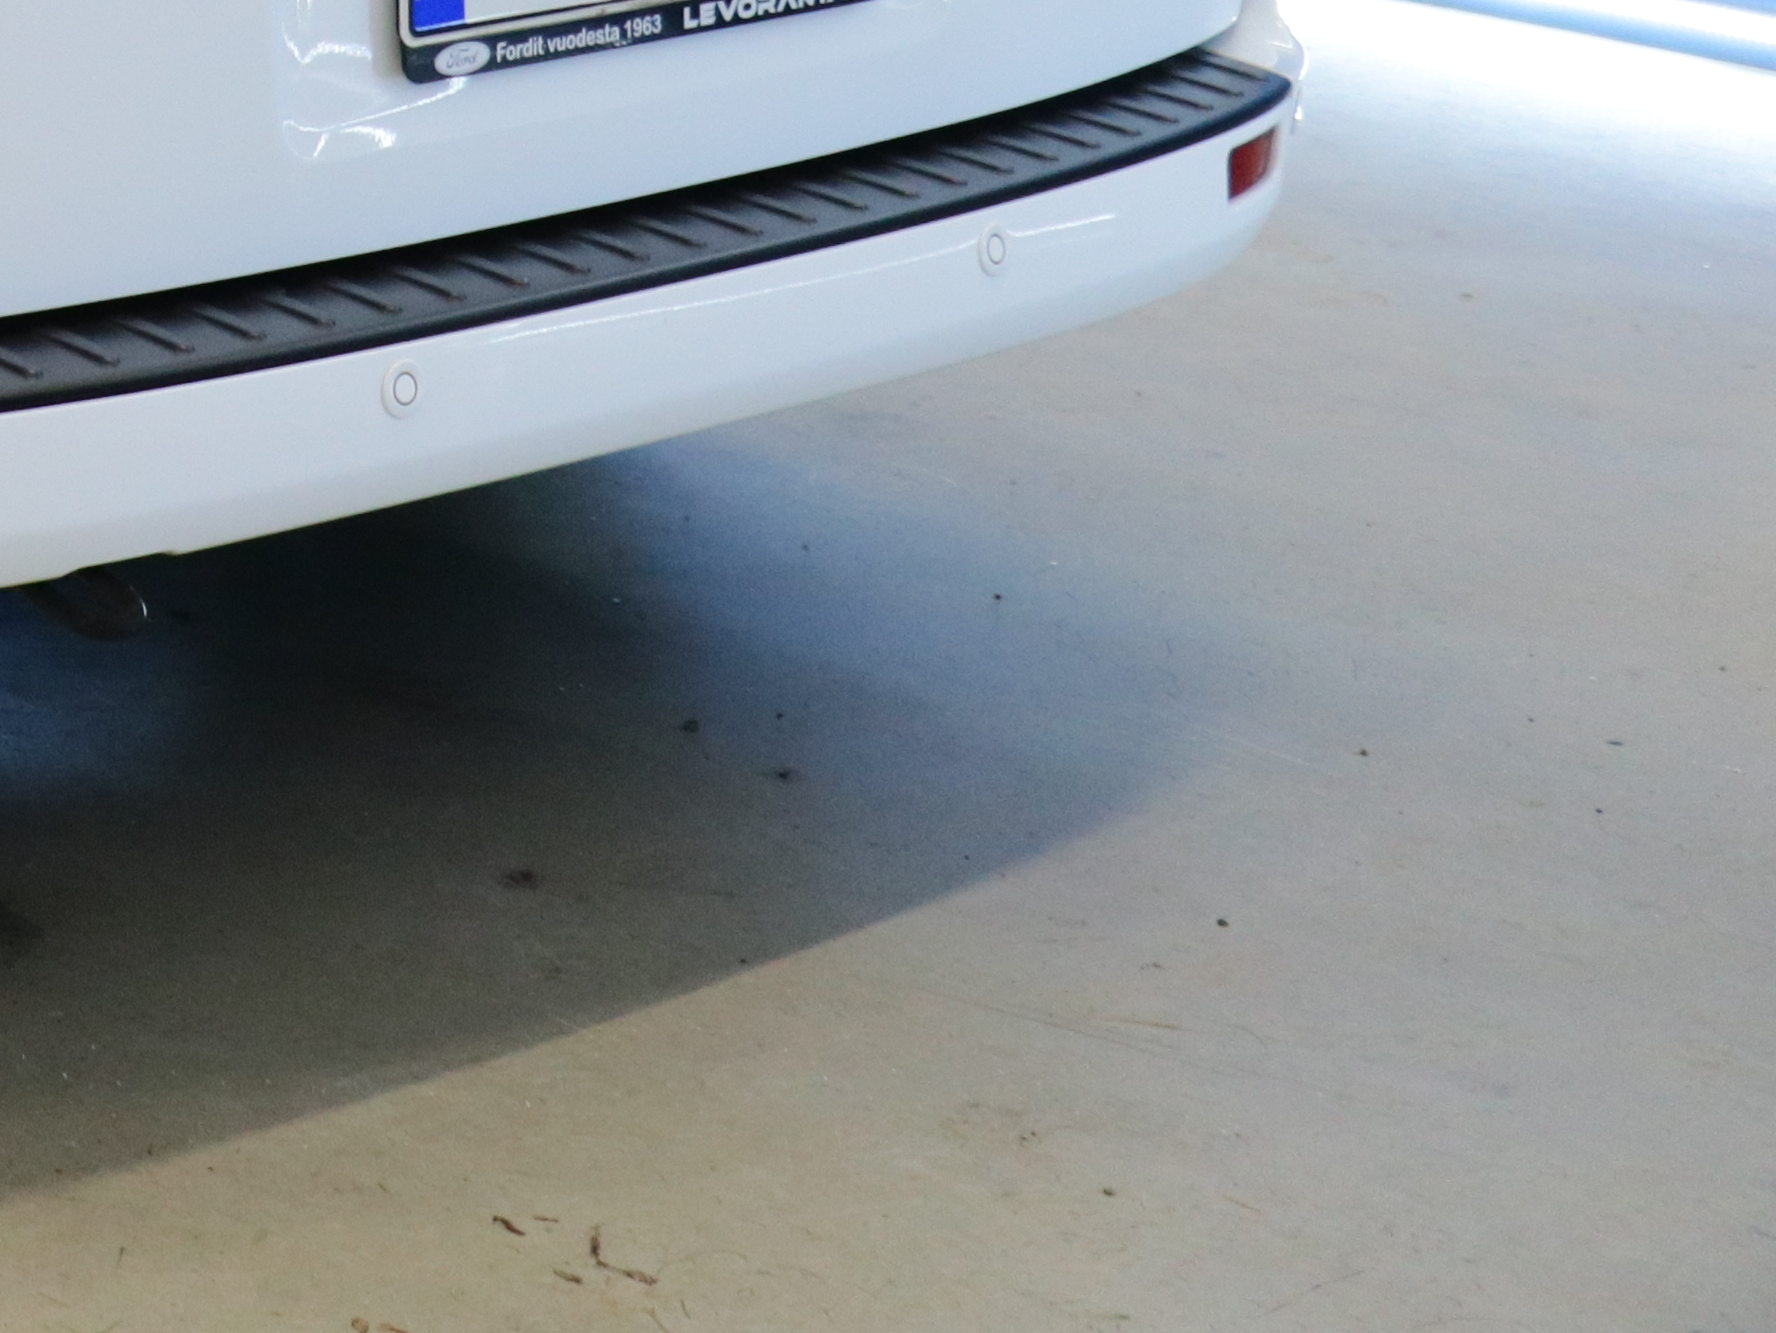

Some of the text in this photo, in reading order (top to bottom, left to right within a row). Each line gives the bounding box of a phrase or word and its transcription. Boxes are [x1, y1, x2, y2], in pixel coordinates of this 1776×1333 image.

[496, 13, 662, 63] Fordit vuodesta 1963
